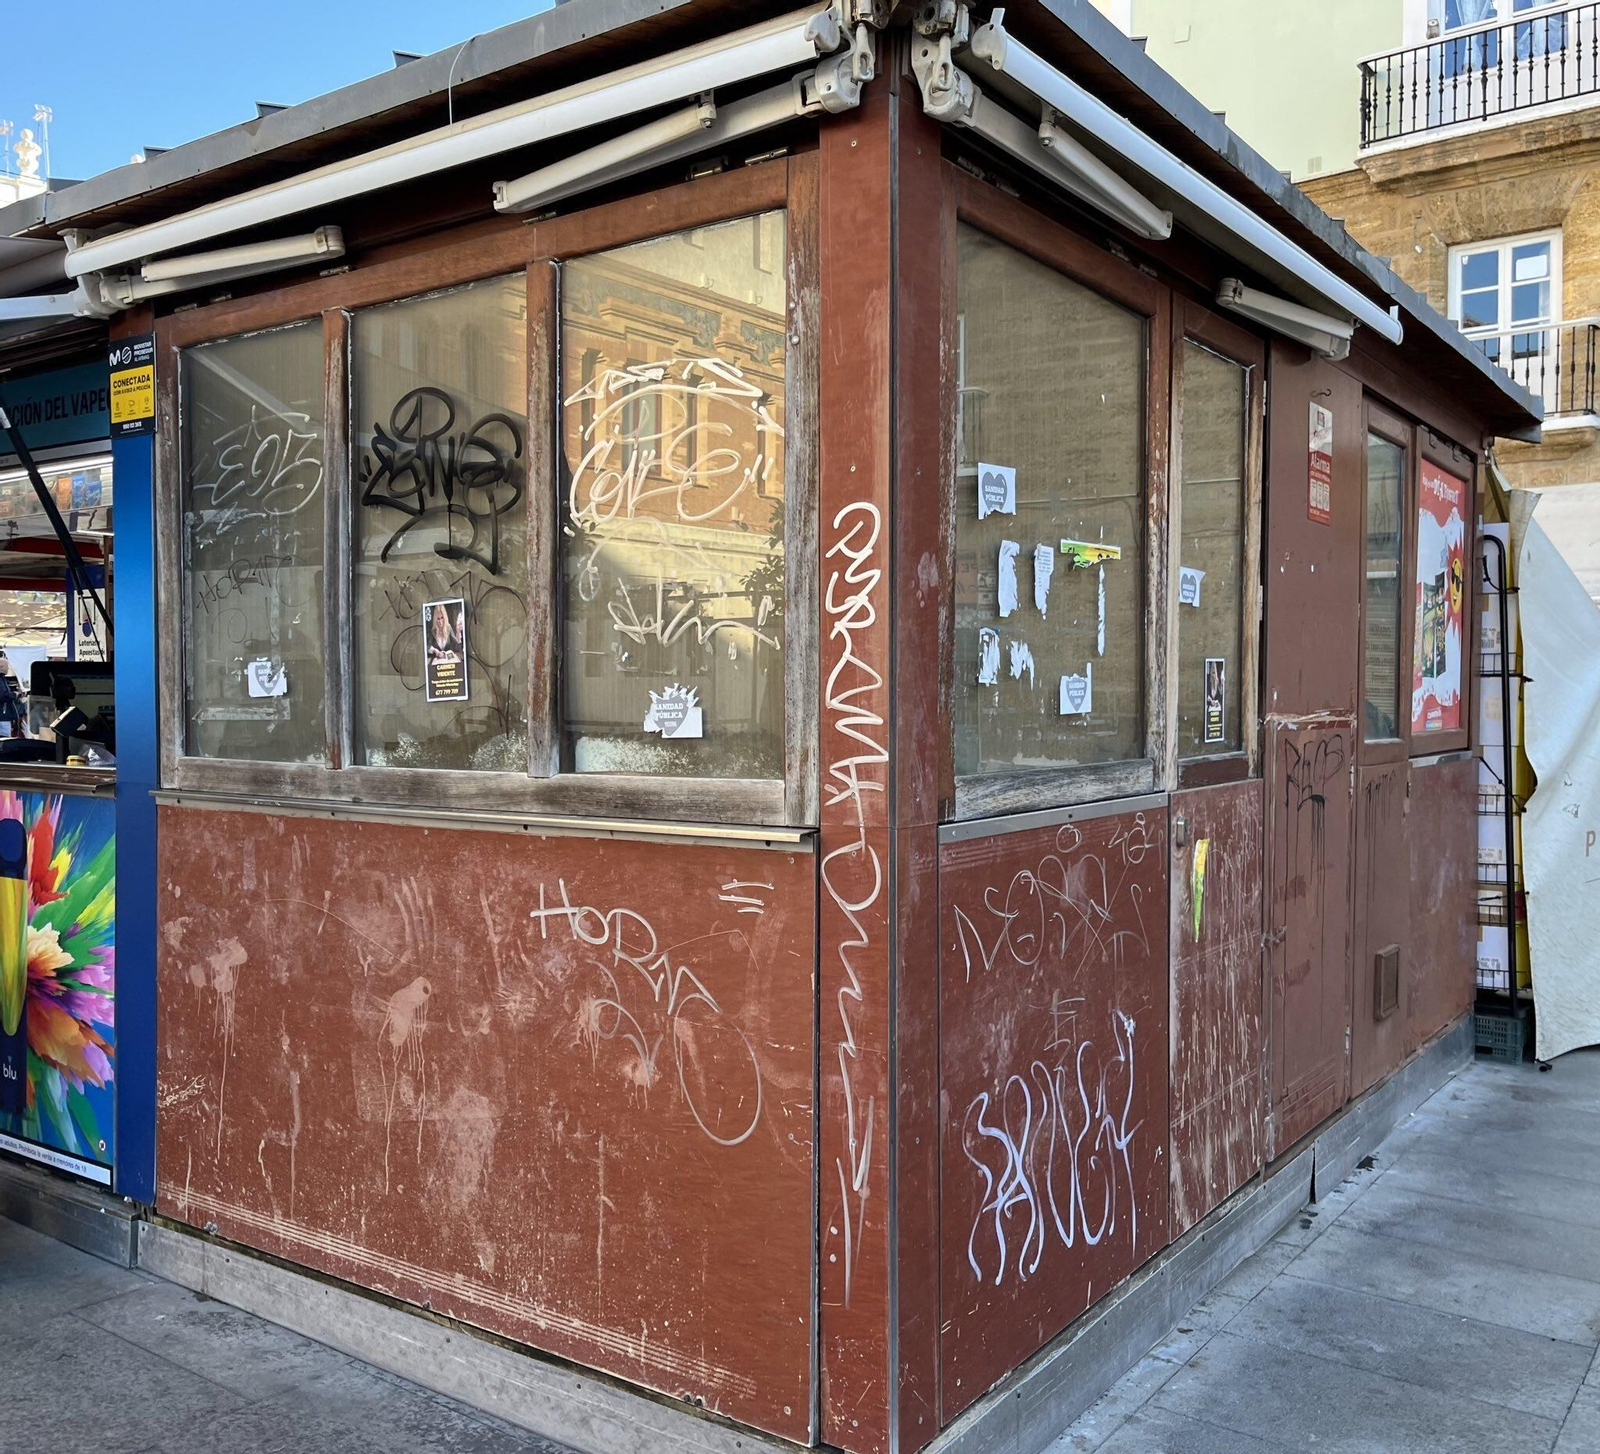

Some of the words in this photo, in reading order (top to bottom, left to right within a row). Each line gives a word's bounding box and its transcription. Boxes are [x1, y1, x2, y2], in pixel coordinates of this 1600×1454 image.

[113, 374, 151, 389] CONECTADA
[45, 397, 68, 421] DEL
[71, 388, 110, 416] VAPE
[985, 485, 1004, 494] SANIDAD
[985, 493, 1004, 503] PÚBLICA
[3, 1064, 17, 1079] blu
[18, 1144, 37, 1156] Prohibida
[42, 1153, 53, 1161] venta
[56, 1157, 75, 1169] menores
[81, 1165, 87, 1173] 18
